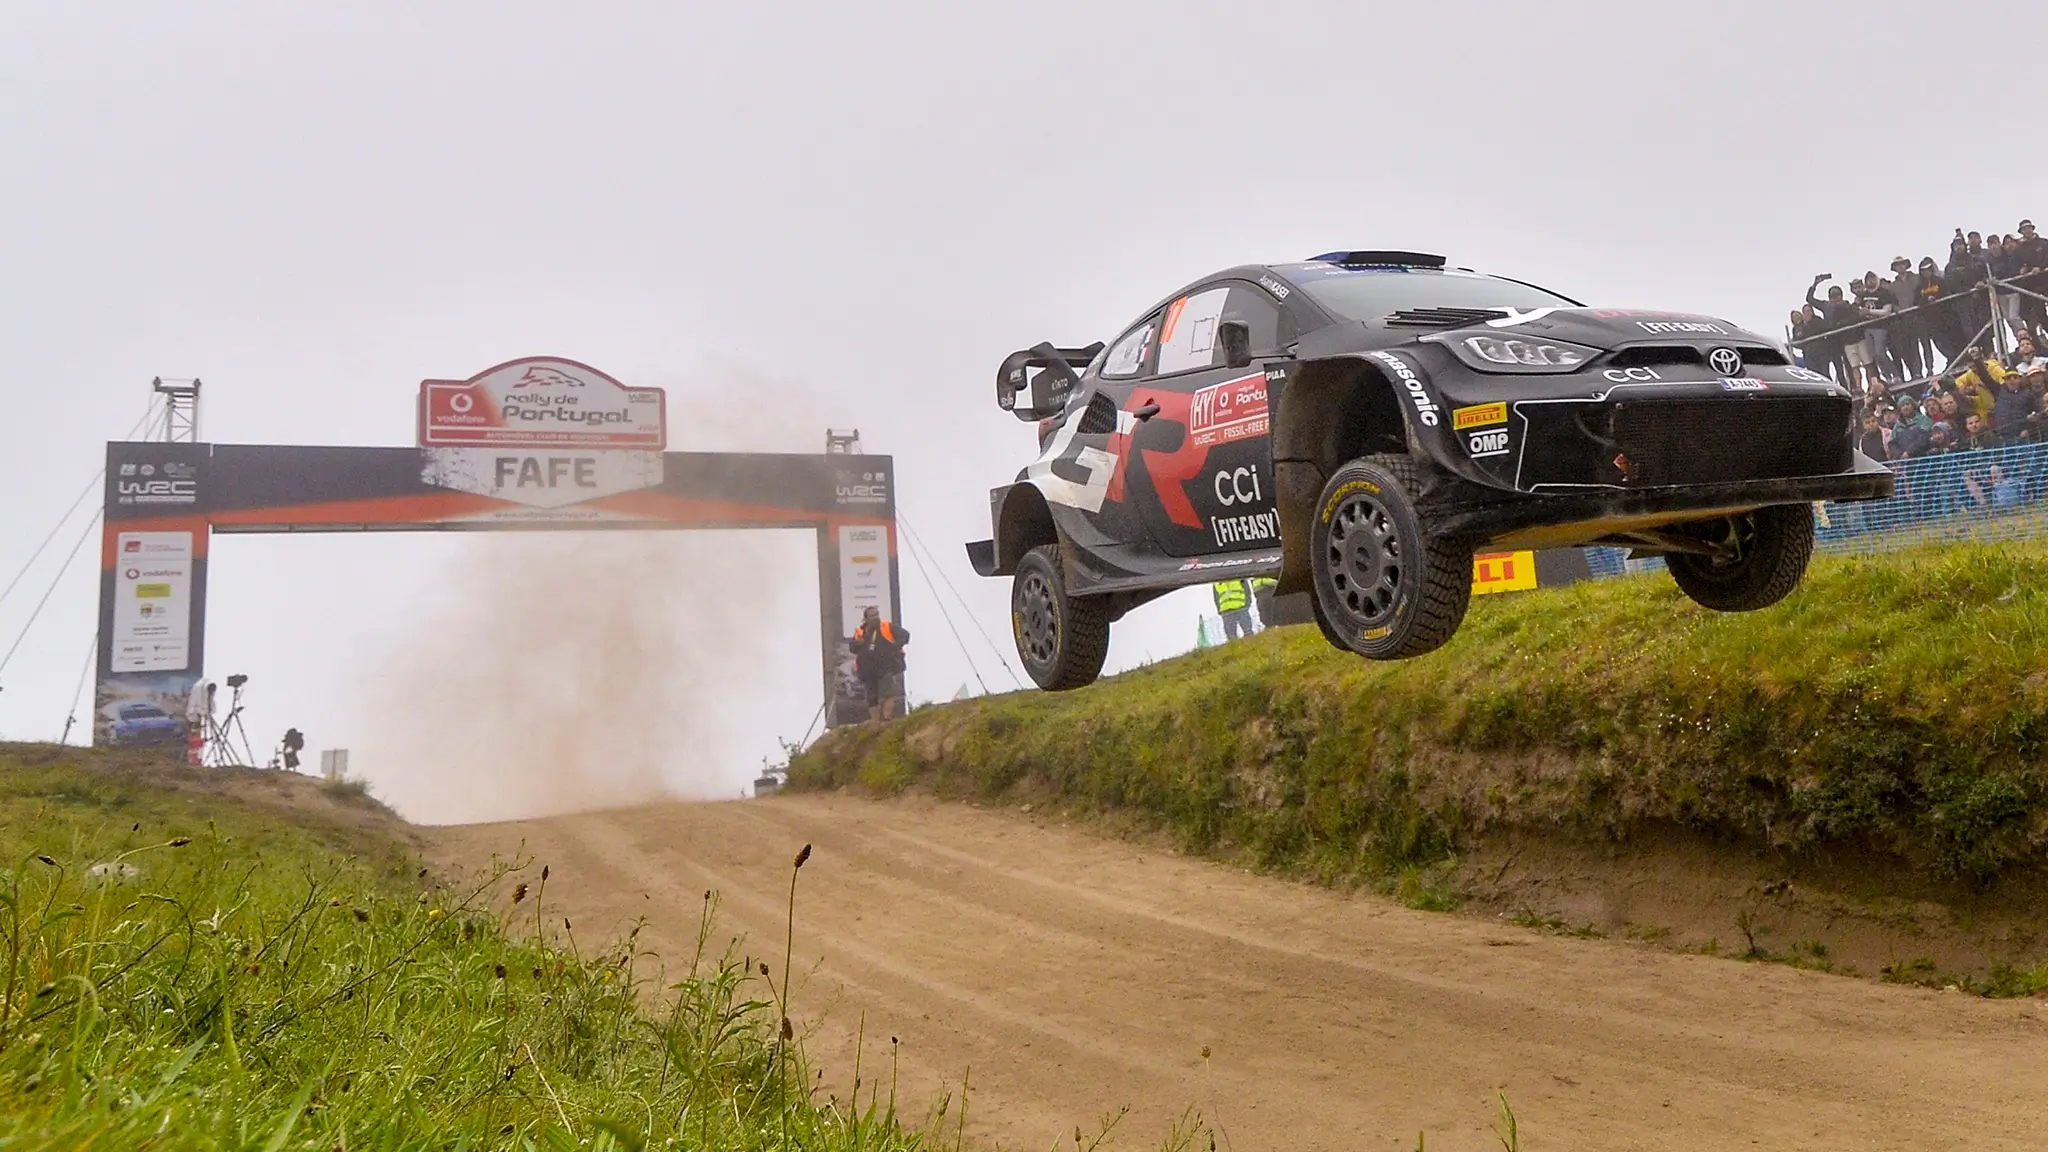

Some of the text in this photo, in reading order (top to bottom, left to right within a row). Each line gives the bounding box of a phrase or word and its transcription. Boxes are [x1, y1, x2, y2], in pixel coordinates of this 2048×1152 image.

[1266, 369, 1286, 381] PIAA
[504, 394, 578, 406] rally de
[436, 414, 486, 424] vodafone
[502, 406, 632, 425] Portugal
[1458, 407, 1500, 425] PIRELLI
[1470, 433, 1509, 453] OMP
[495, 457, 596, 488] FAFE
[119, 481, 196, 494] WRC
[836, 485, 885, 497] WRC
